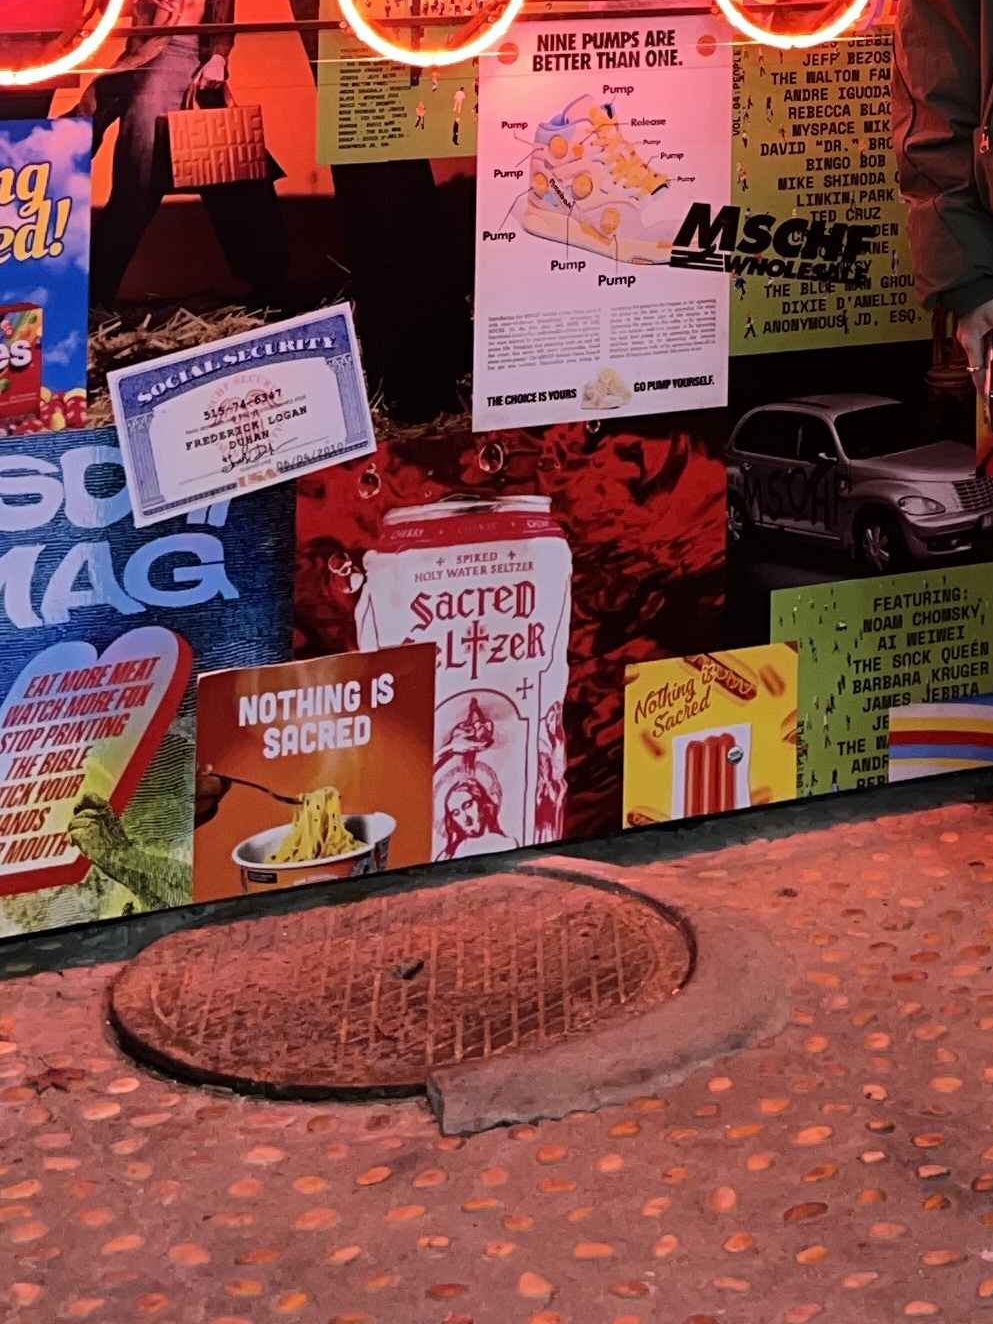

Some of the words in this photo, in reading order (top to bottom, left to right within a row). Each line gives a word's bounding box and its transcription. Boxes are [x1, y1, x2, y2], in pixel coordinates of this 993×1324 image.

[537, 33, 577, 52] NINE
[582, 31, 640, 50] PUMPS
[644, 29, 676, 47] ARE
[532, 52, 592, 72] BETTER
[597, 50, 640, 69] THAN
[651, 49, 683, 67] ONE.
[847, 50, 891, 65] BEZOS
[771, 71, 797, 85] THE
[806, 69, 860, 84] WALTON
[603, 84, 634, 96] Pump
[784, 87, 829, 103] ANDRE
[838, 85, 891, 100] IGUODA
[788, 103, 851, 120] REBECCA
[501, 121, 528, 131] Pump
[630, 117, 666, 127] Release
[792, 120, 855, 137] MYSPACE
[863, 119, 890, 134] MIK
[660, 151, 684, 161] Pump
[760, 141, 806, 157] DAVID
[806, 155, 851, 172] BINGO
[860, 154, 887, 169] BOB
[493, 169, 524, 179] Pump
[777, 177, 814, 191] MIKE
[823, 171, 887, 188] SHINODA
[797, 192, 850, 207] LINKIN
[859, 189, 895, 205] PARK
[811, 209, 837, 222] TED
[845, 206, 881, 220] CRUZ
[482, 230, 516, 243] Pump
[672, 202, 877, 262] MSCHF
[550, 259, 586, 273] Pump
[598, 274, 636, 289] Pump
[764, 283, 791, 298] THE
[800, 280, 836, 295] BLUE
[782, 298, 828, 315] DIXIE
[836, 292, 907, 311] D'AMELIO
[762, 315, 844, 335] ANONYMOUS
[889, 308, 923, 324] ESQ.
[137, 358, 222, 407] SOCIAL
[222, 335, 338, 366] SECURITY
[633, 381, 647, 393] GO
[647, 379, 672, 392] PUMP
[672, 375, 715, 388] YOURSELF.
[487, 396, 504, 408] THE
[504, 392, 537, 406] CHOICE
[538, 391, 548, 402] IS
[548, 388, 577, 401] YOURS
[185, 419, 260, 451] FREDERICK
[267, 405, 308, 426] LOGAN
[414, 569, 444, 583] HOLY
[446, 566, 488, 580] WATER
[490, 561, 534, 575] SELTZER
[873, 587, 969, 612] FEATURING:
[863, 616, 903, 633] NOAM
[877, 635, 897, 651] AI
[906, 626, 965, 647] WEIWEI
[853, 656, 882, 674] THE
[892, 649, 932, 669] SOCK
[941, 642, 990, 662] QUEEN
[23, 671, 58, 699] EAT
[57, 664, 112, 694] MORE
[108, 656, 161, 685] MEAT
[852, 671, 922, 694] BARBARA
[931, 661, 990, 683] KRUGER
[3, 698, 67, 727] WATCH
[63, 688, 116, 719] MORE
[115, 682, 155, 710] FOX
[239, 680, 361, 727] NOTHING
[371, 673, 395, 708] IS
[634, 677, 697, 725] Nothing
[862, 692, 912, 713] JAMES
[652, 685, 711, 738] Sacred
[0, 726, 45, 755] STOP
[41, 713, 131, 748] PRINTING
[263, 715, 371, 760] SACRED
[836, 738, 866, 756] THE
[4, 751, 42, 781] THE
[39, 745, 94, 776] BIBLE
[34, 774, 86, 805] YOUR
